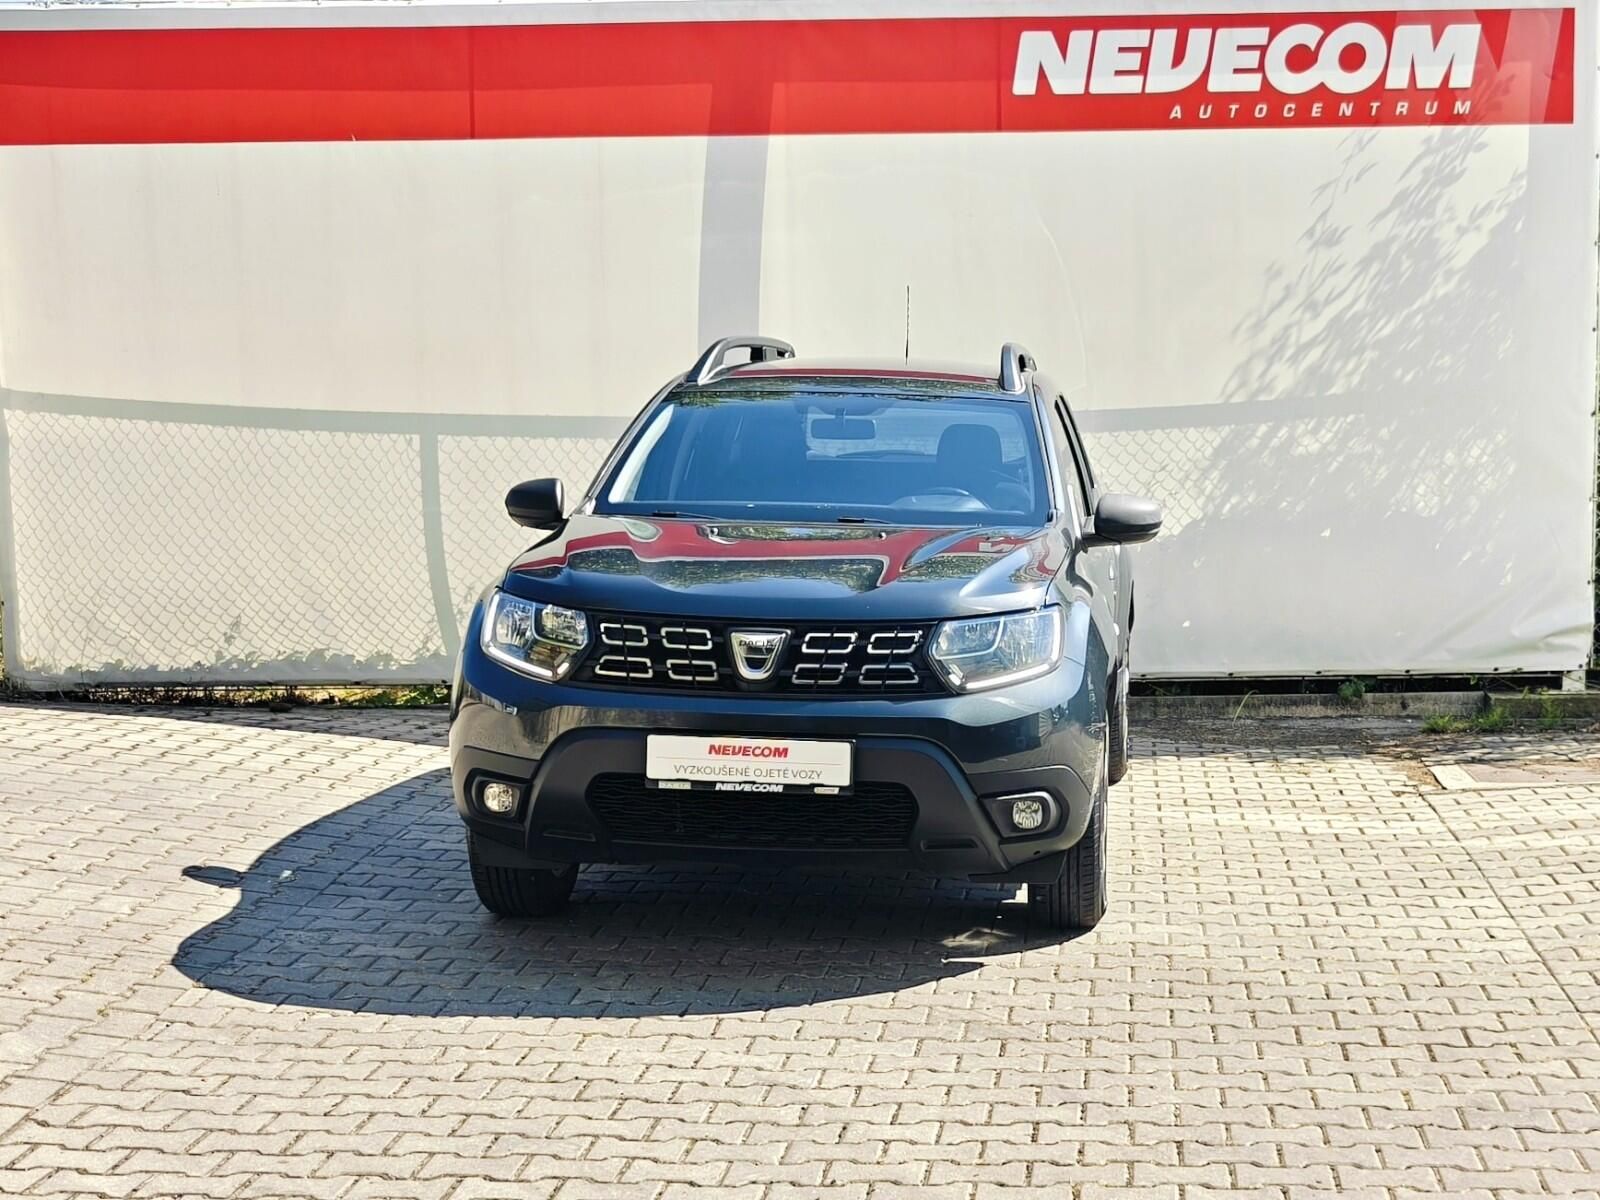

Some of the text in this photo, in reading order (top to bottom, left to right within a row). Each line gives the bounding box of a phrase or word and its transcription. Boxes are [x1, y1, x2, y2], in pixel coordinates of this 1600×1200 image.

[1012, 22, 1481, 95] NEVECOM
[1169, 101, 1471, 120] AUTOCENTRUM
[708, 744, 789, 758] NEVECOM
[673, 764, 822, 780] VYZKOUŠENÉ OJETÉ VOZY
[715, 782, 784, 793] NEVECOM
